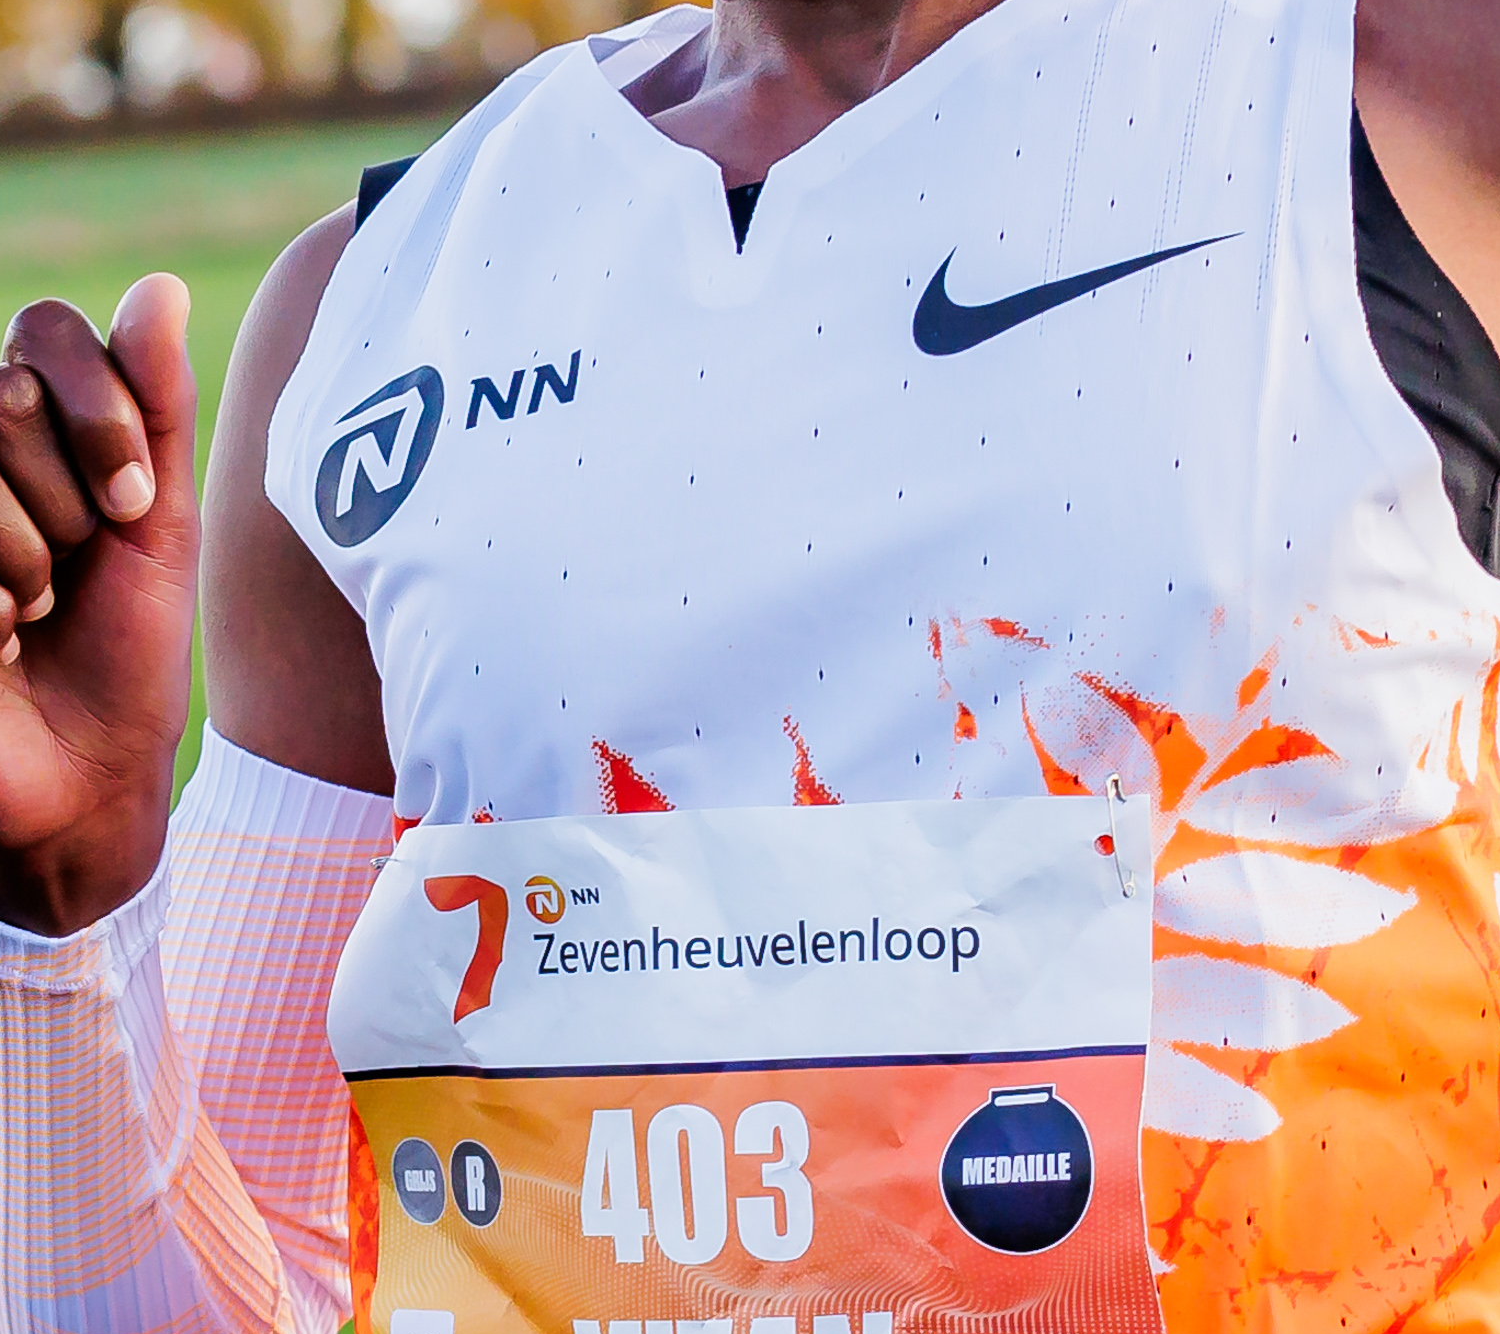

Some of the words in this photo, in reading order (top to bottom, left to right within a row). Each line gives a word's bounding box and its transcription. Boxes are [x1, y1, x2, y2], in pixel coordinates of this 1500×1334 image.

[465, 349, 581, 430] NN
[570, 887, 600, 905] NN
[423, 874, 509, 1025] 7
[533, 919, 981, 975] Zevenheuvelenloop
[465, 1155, 486, 1212] R
[580, 1101, 814, 1265] 403
[962, 1152, 1071, 1185] MEDAILLE
